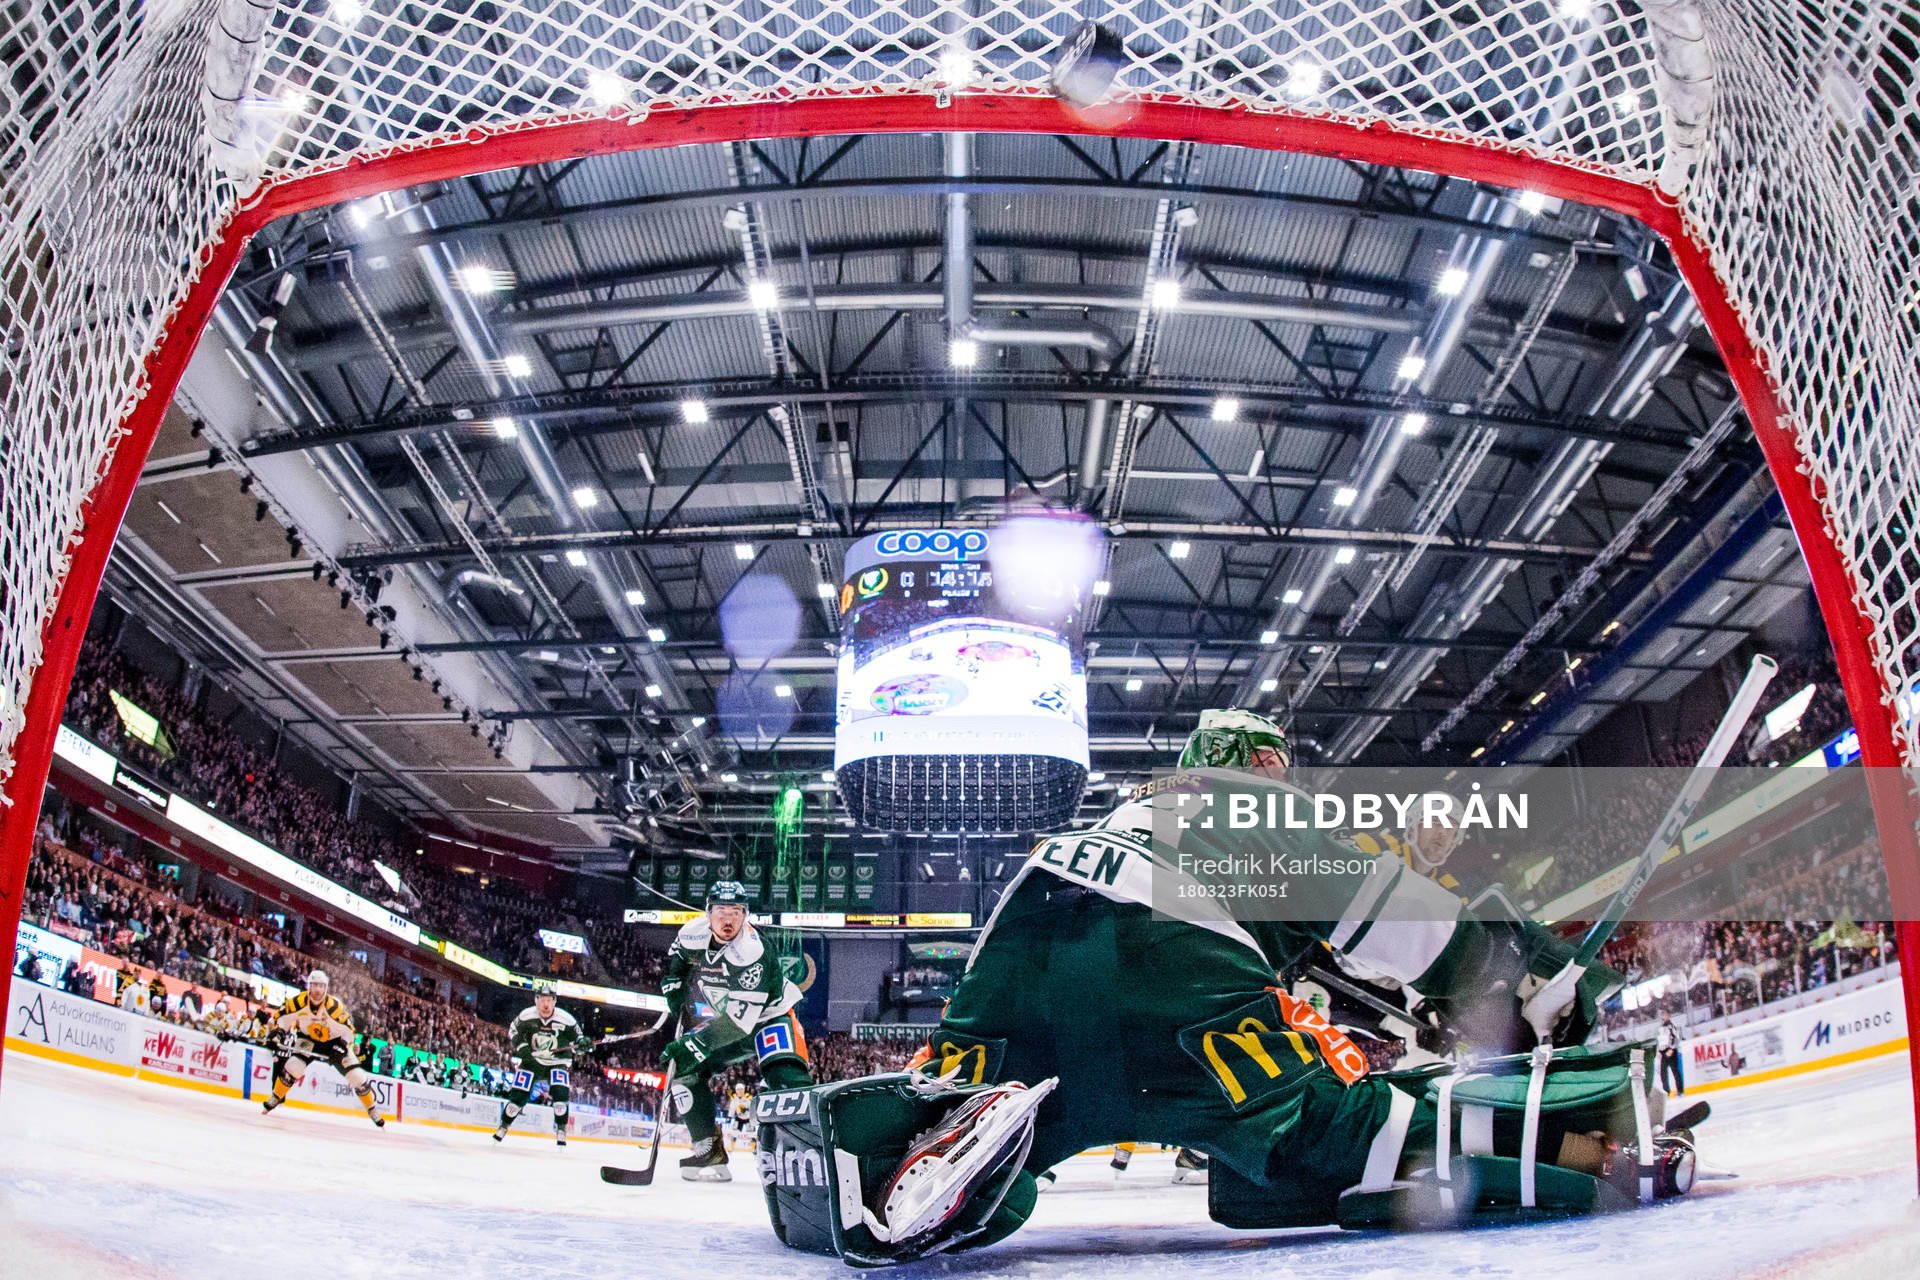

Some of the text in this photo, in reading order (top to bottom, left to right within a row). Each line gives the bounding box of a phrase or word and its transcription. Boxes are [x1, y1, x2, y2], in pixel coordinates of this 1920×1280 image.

[875, 530, 990, 560] coop
[1837, 1011, 1894, 1037] MIDROC
[64, 1026, 117, 1055] ALLIANS
[1694, 1042, 1727, 1064] MAXI
